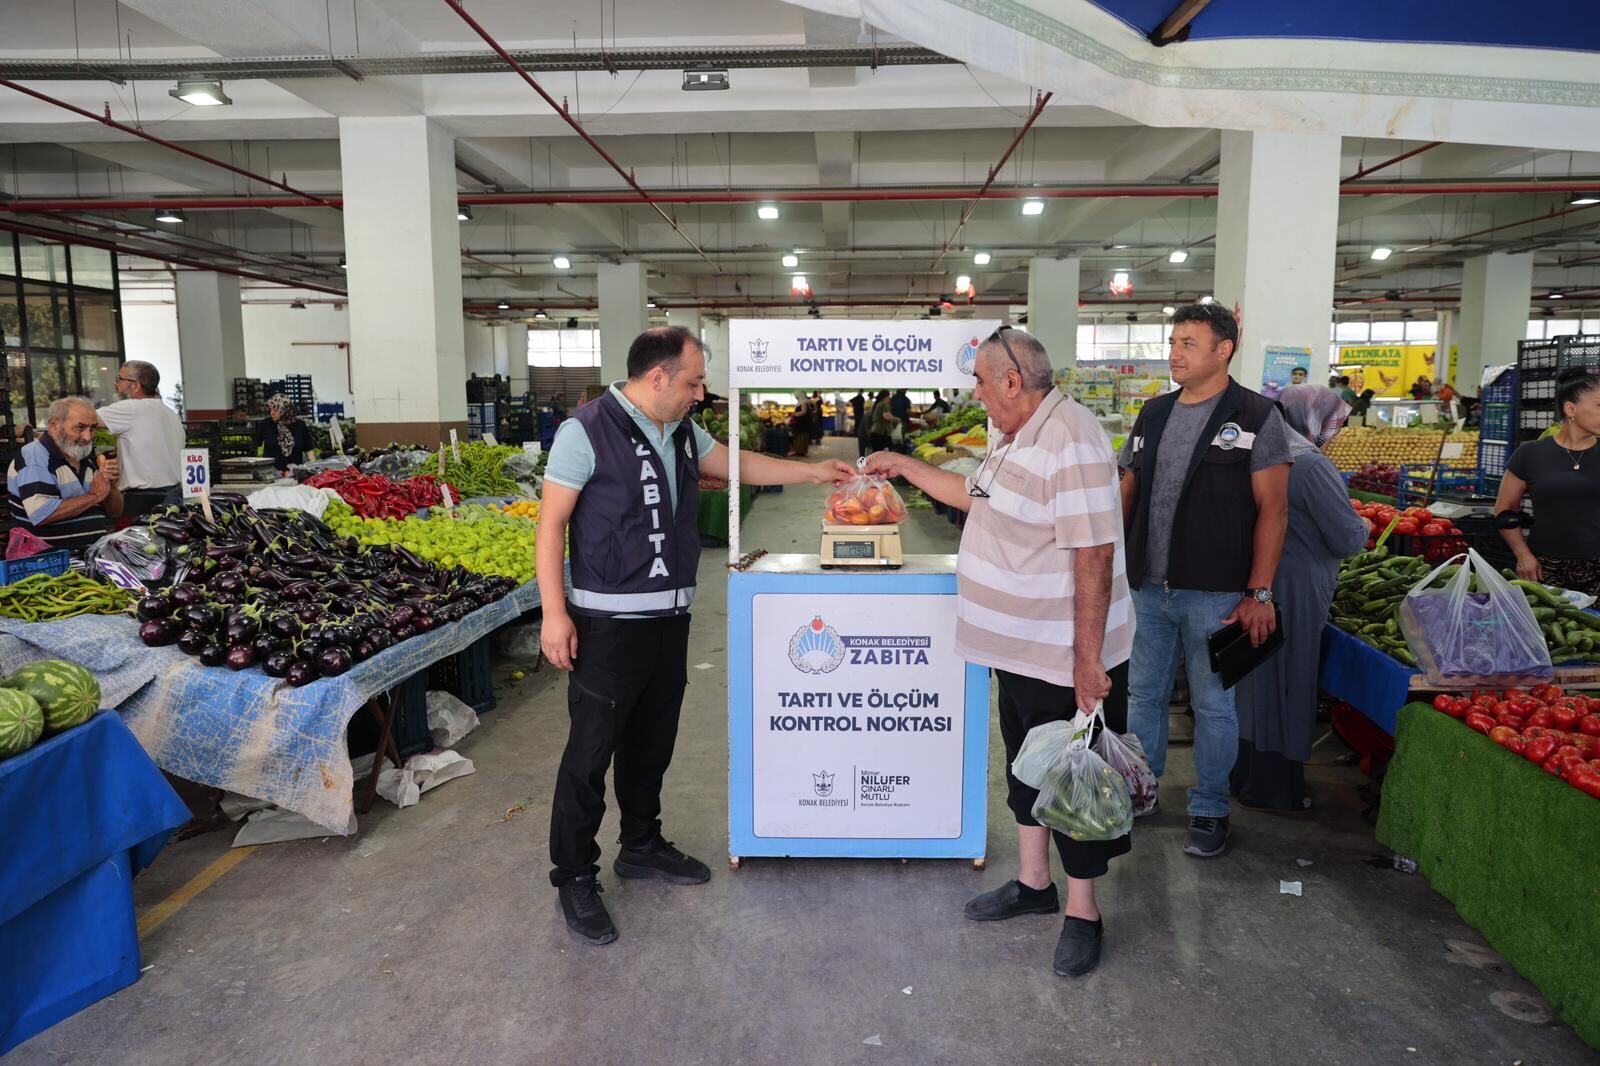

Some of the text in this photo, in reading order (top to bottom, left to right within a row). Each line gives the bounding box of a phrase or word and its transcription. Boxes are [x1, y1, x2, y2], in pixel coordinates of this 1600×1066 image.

[797, 334, 932, 355] TARTI VE ÖLÇÜM
[790, 358, 943, 373] KONTROL NOKTASI
[185, 464, 206, 485] 30
[850, 637, 929, 646] KONAK BELEDİYESİ
[850, 649, 929, 665] ZABITA
[778, 688, 939, 712] TARTI VE ÖLÇÜM
[770, 716, 952, 732] KONTROL NOKTASI
[861, 785, 895, 793] ÇINARLI
[798, 799, 818, 807] KONAK
[861, 793, 890, 801] MUTLU
